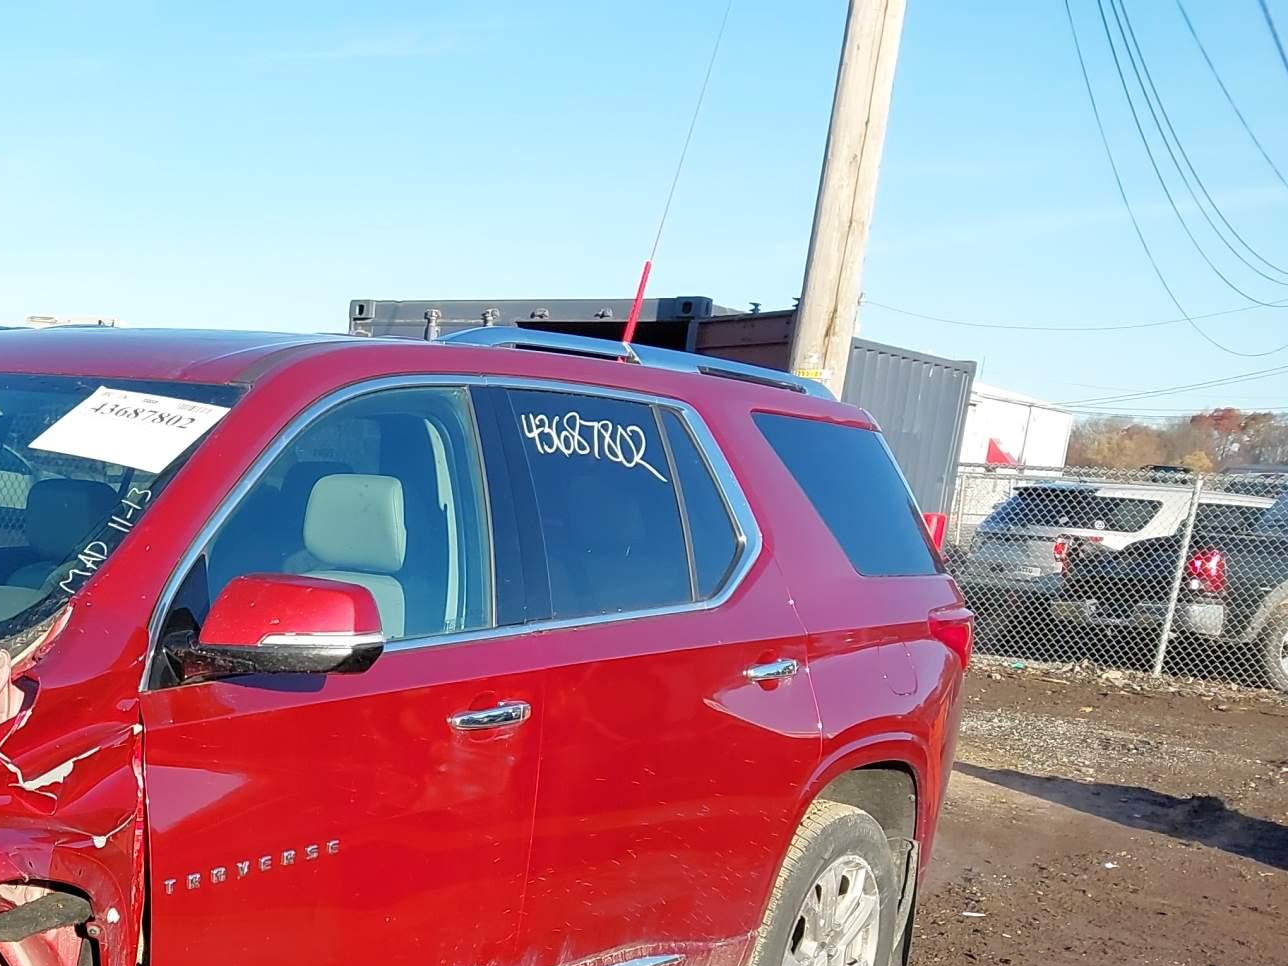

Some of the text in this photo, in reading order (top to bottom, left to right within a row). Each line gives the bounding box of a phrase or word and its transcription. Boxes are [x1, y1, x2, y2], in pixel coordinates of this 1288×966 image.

[90, 402, 197, 430] 43687802
[521, 411, 668, 483] 43687802
[59, 487, 152, 594] MAD 11-13
[164, 839, 340, 895] TRAVERSE
